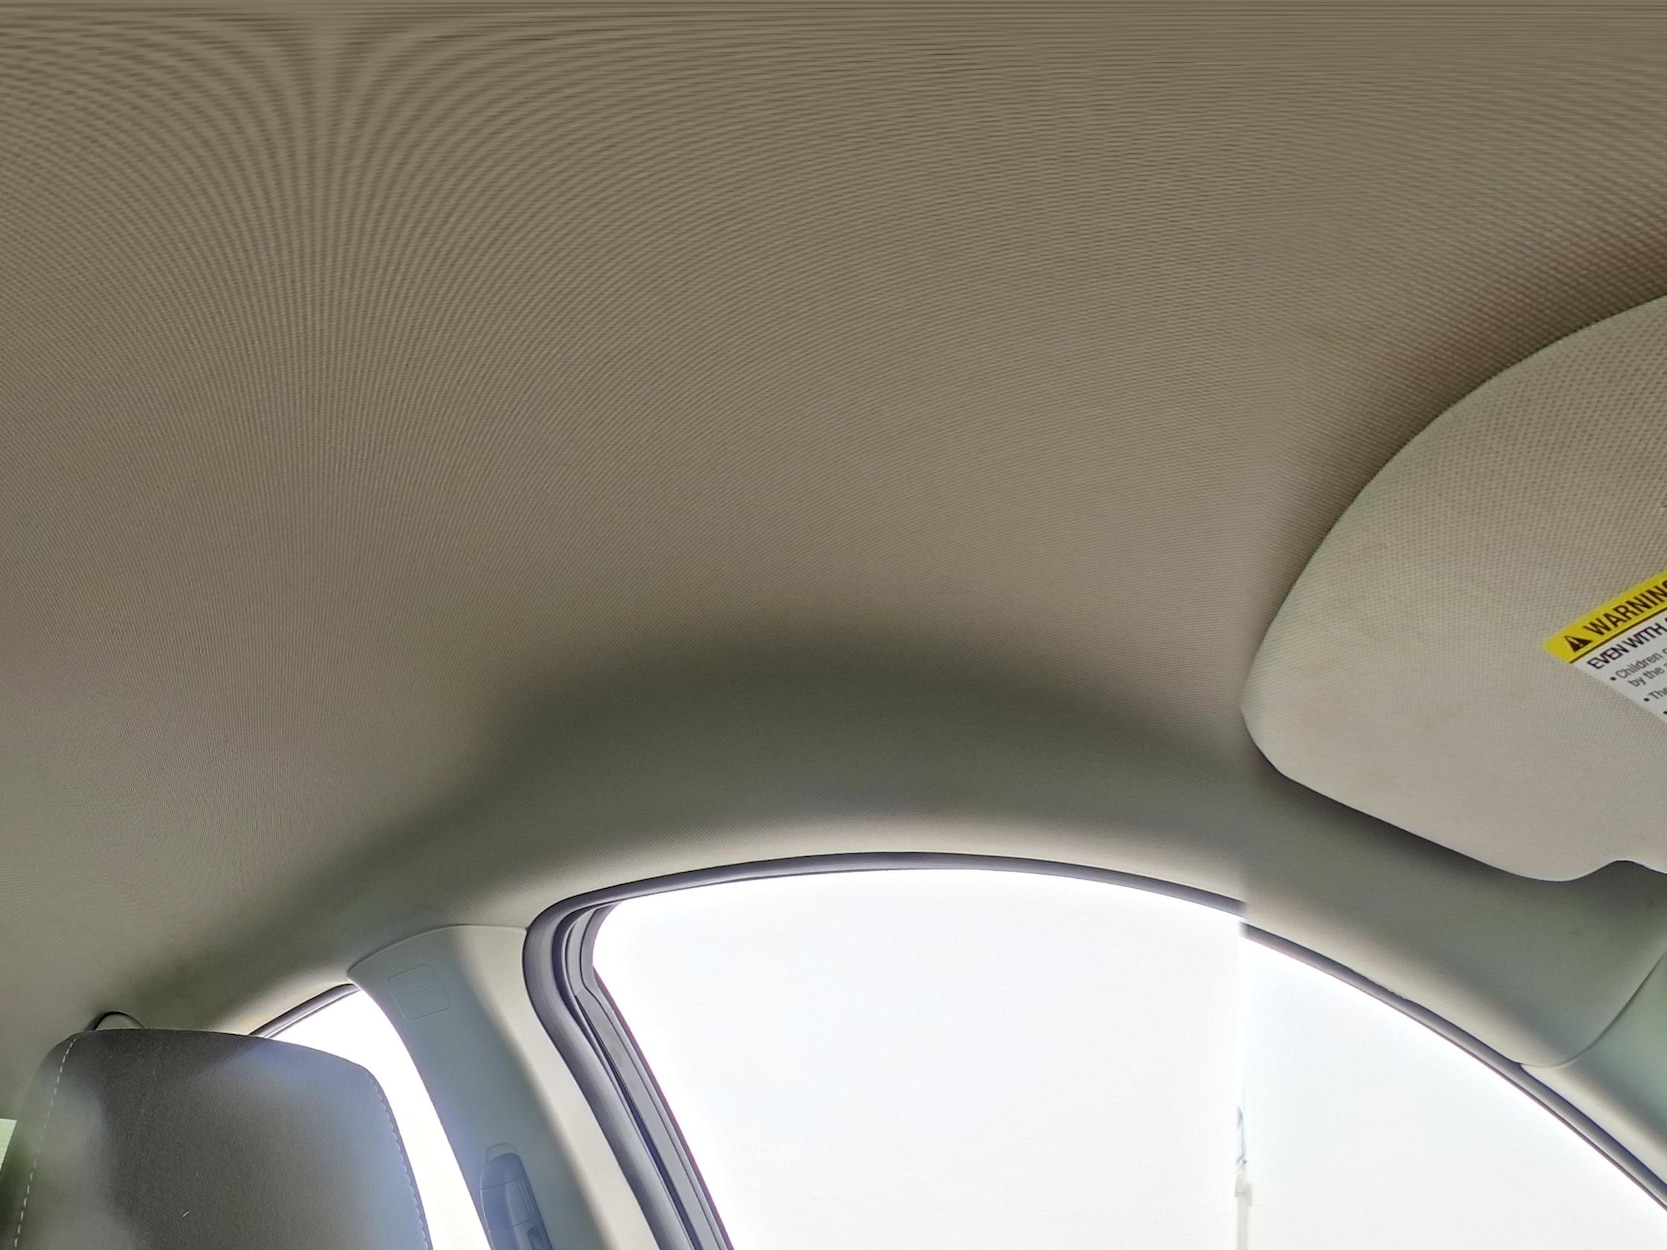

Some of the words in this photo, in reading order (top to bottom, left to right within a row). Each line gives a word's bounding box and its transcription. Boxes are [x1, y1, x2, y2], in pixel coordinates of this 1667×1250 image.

[1587, 644, 1629, 670] EVEN
[1622, 623, 1667, 649] WITH
[1616, 650, 1663, 679] Children
[1628, 677, 1645, 687] by
[1644, 665, 1664, 680] the
